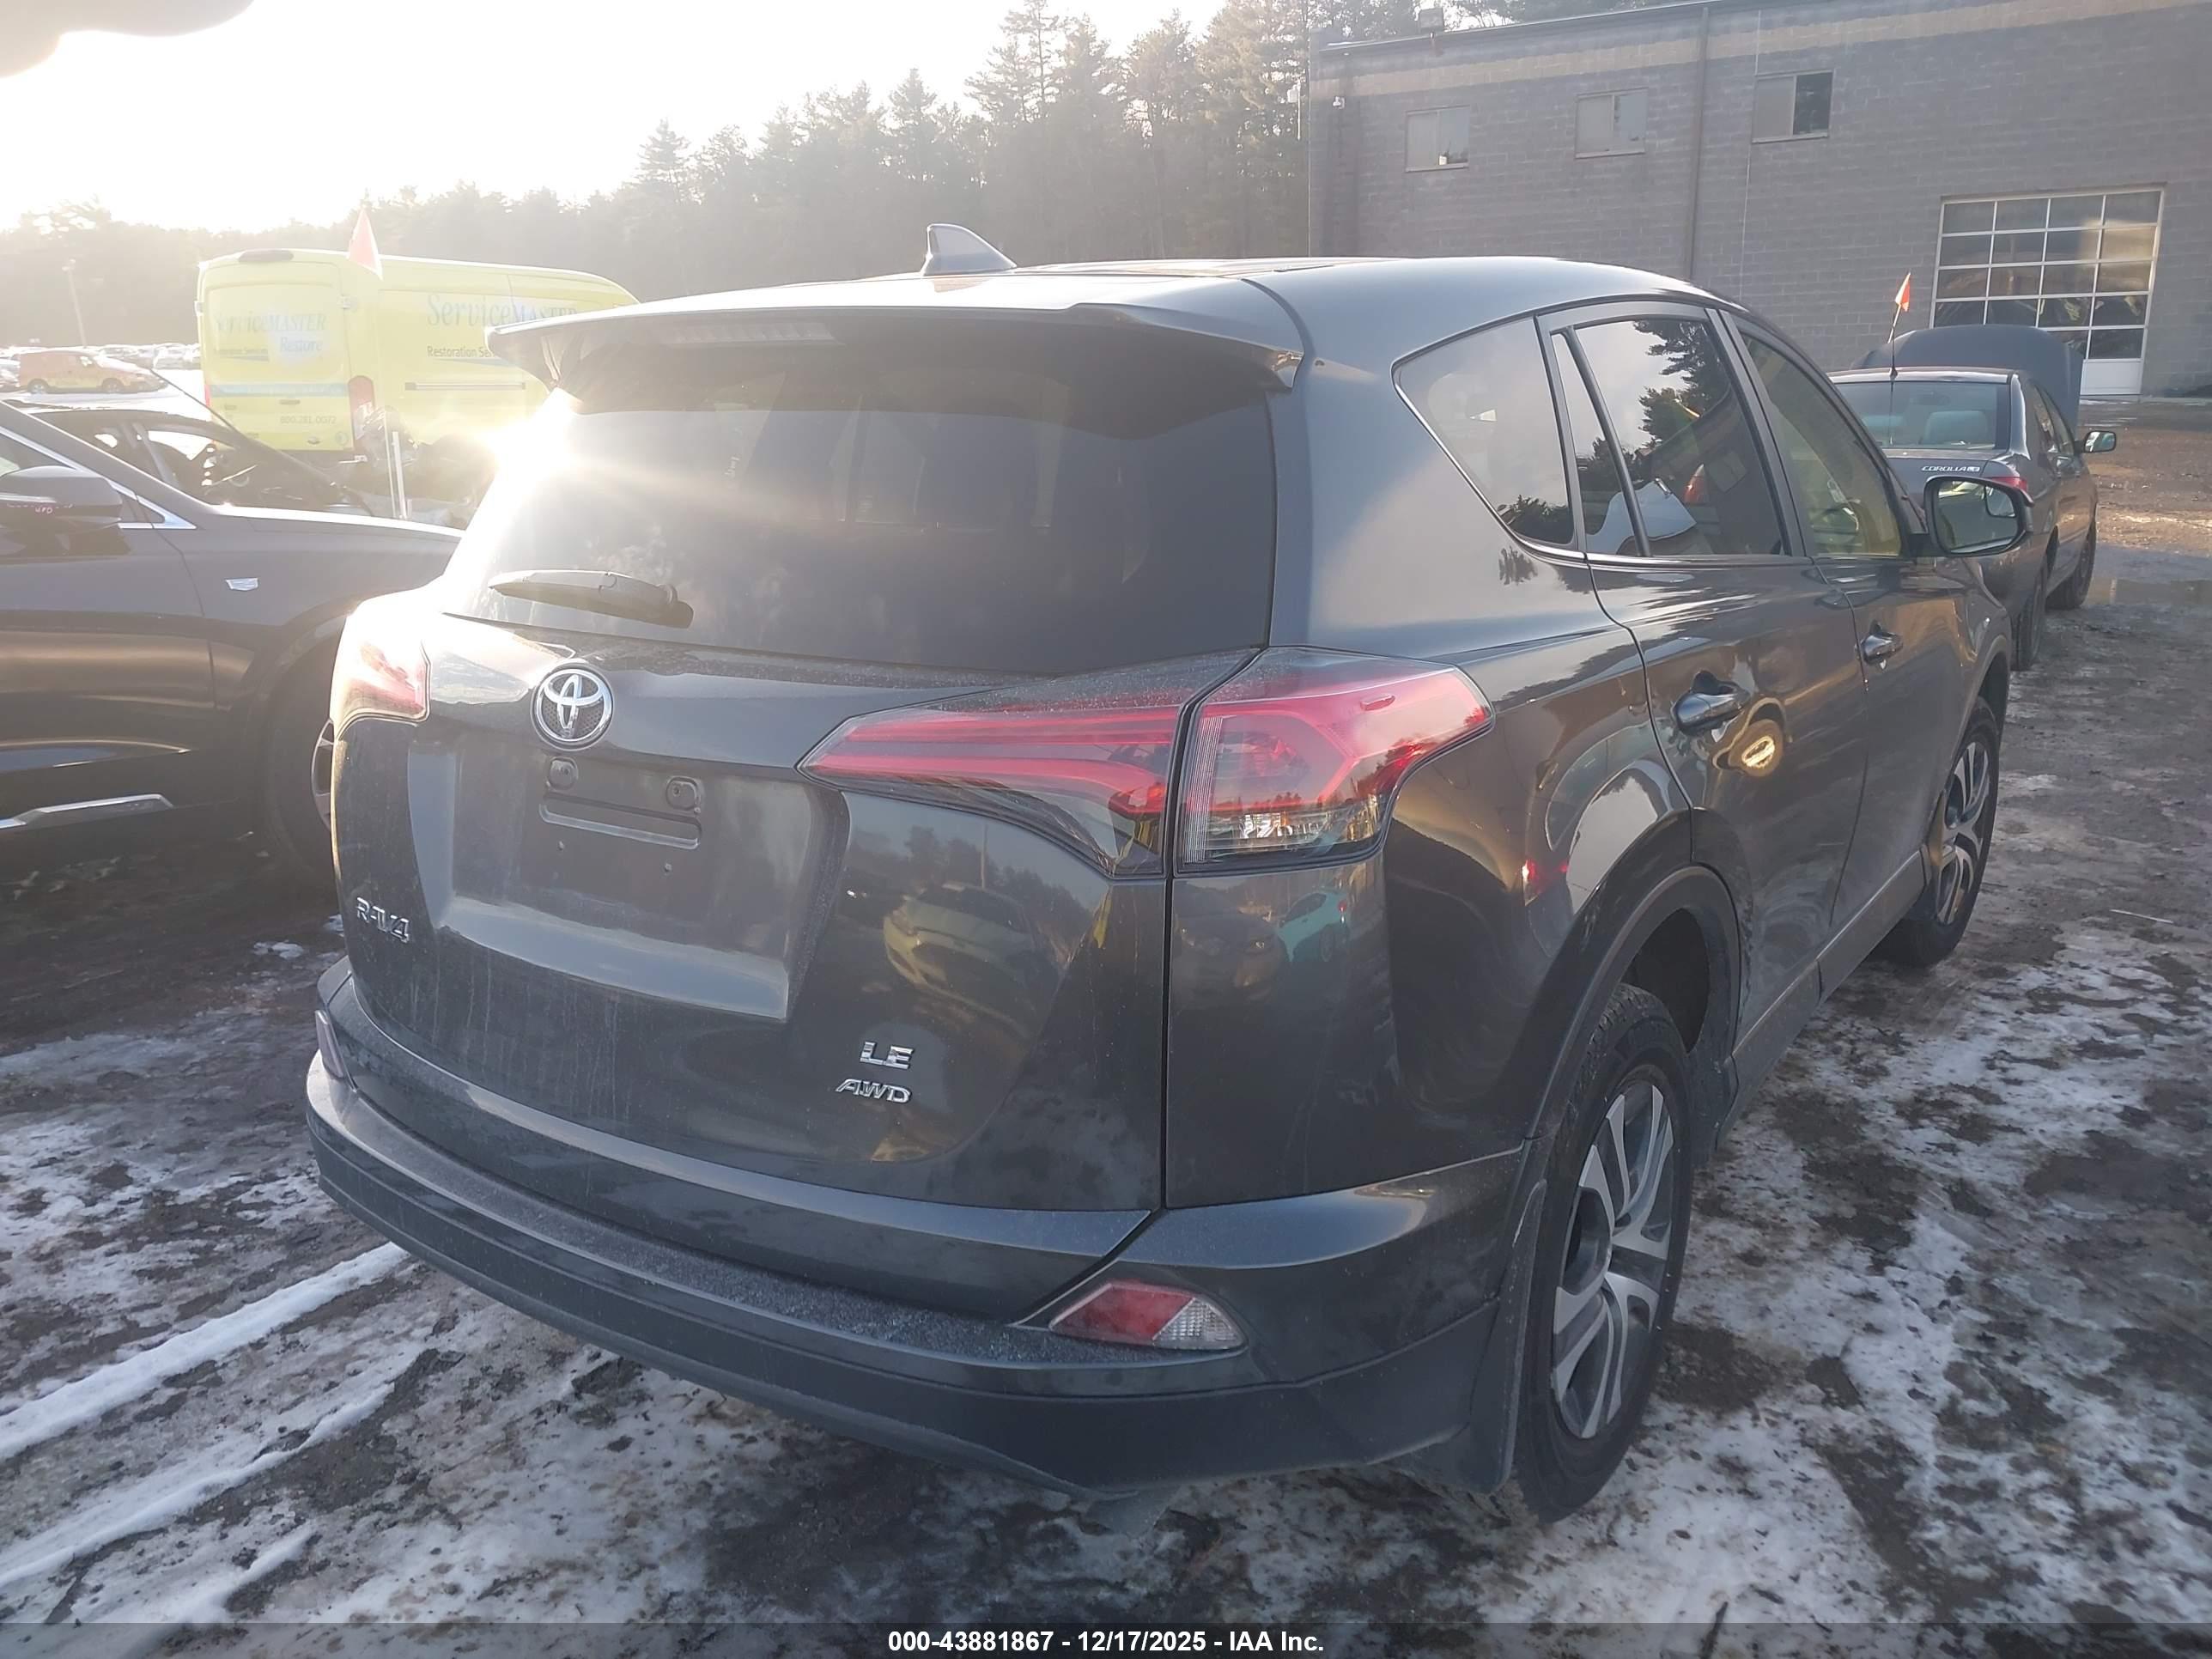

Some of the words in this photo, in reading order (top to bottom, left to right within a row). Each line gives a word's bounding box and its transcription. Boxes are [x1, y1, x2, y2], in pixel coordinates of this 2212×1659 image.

[427, 344, 477, 358] Restoration
[356, 897, 410, 943] RAV4
[860, 1041, 914, 1070] LE
[836, 1079, 912, 1103] AWD
